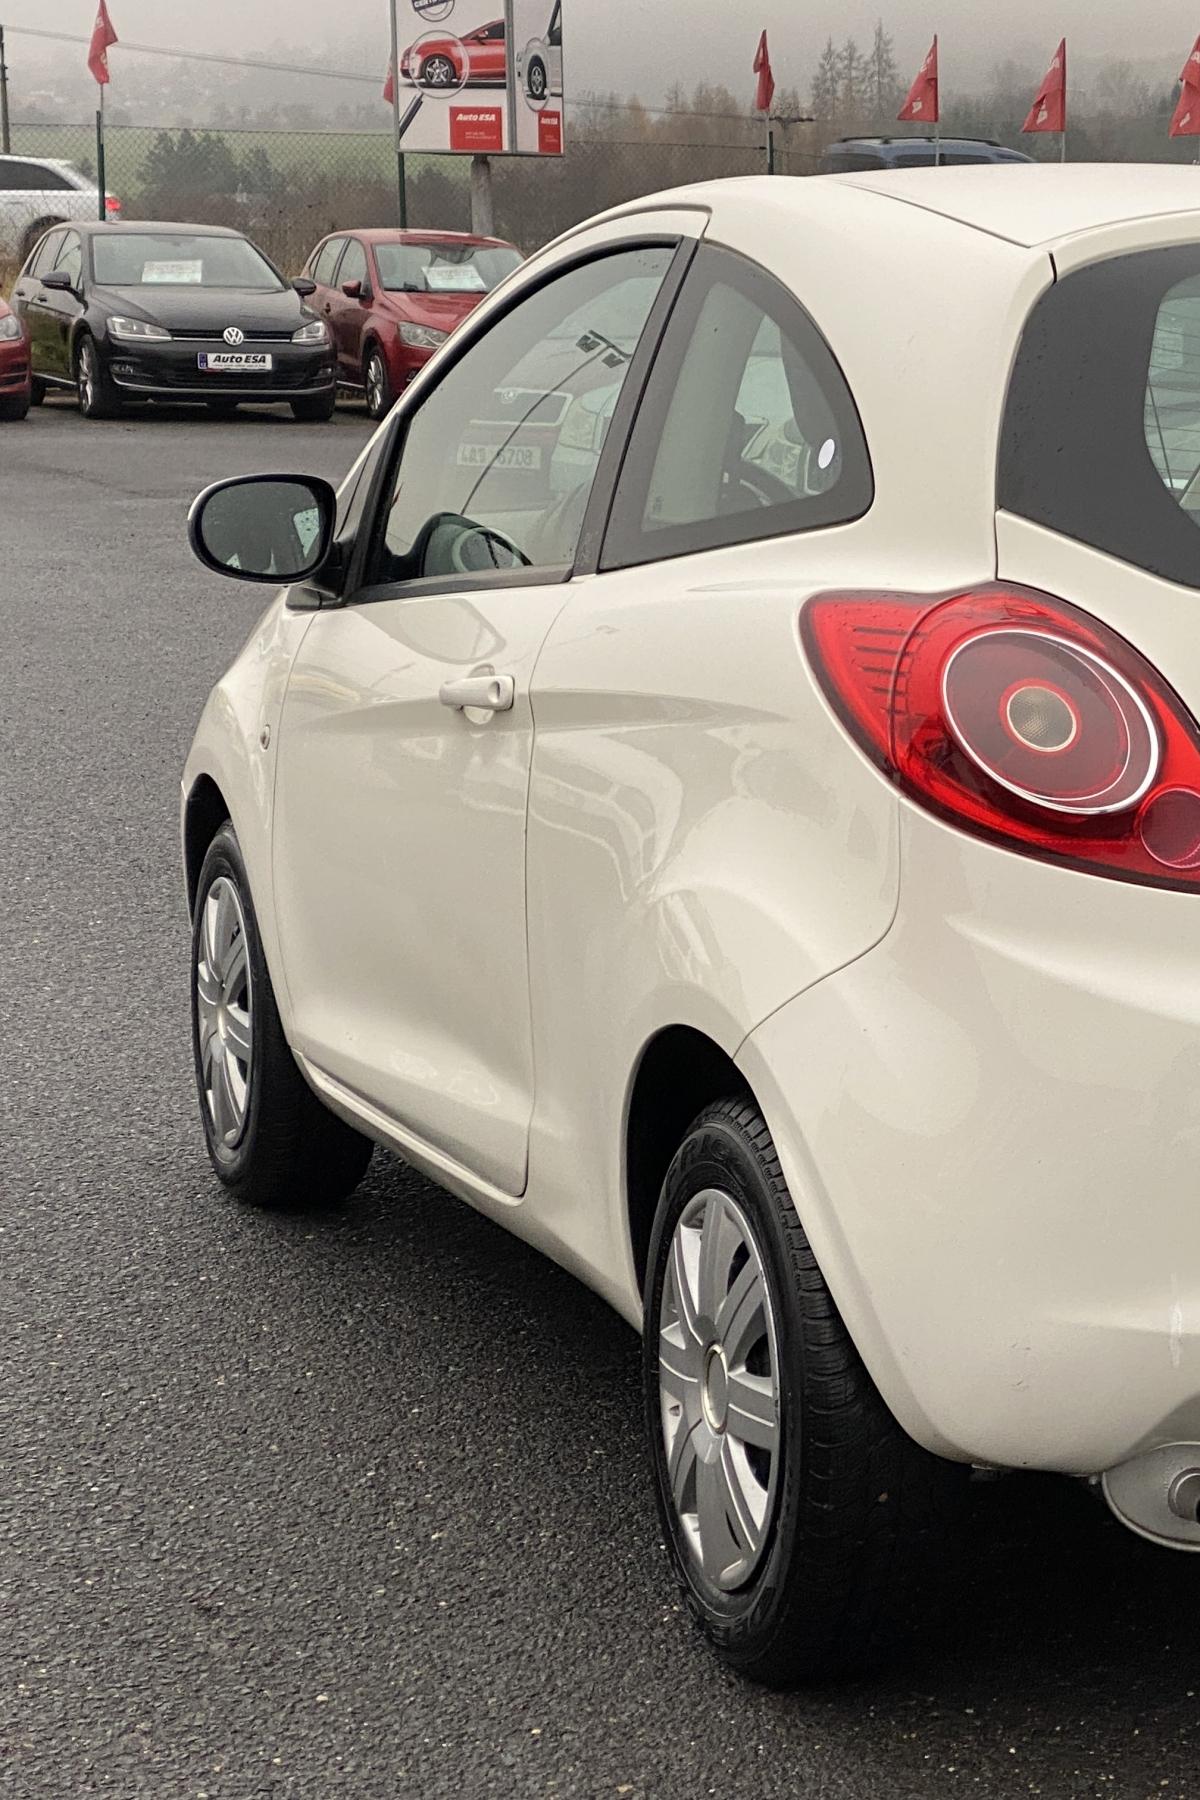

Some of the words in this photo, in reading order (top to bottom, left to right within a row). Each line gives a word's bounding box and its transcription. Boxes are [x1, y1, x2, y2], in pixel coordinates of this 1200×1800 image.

[456, 113, 478, 121] Auto
[478, 113, 496, 121] ESA
[213, 355, 243, 363] Auto
[244, 355, 266, 363] ESA
